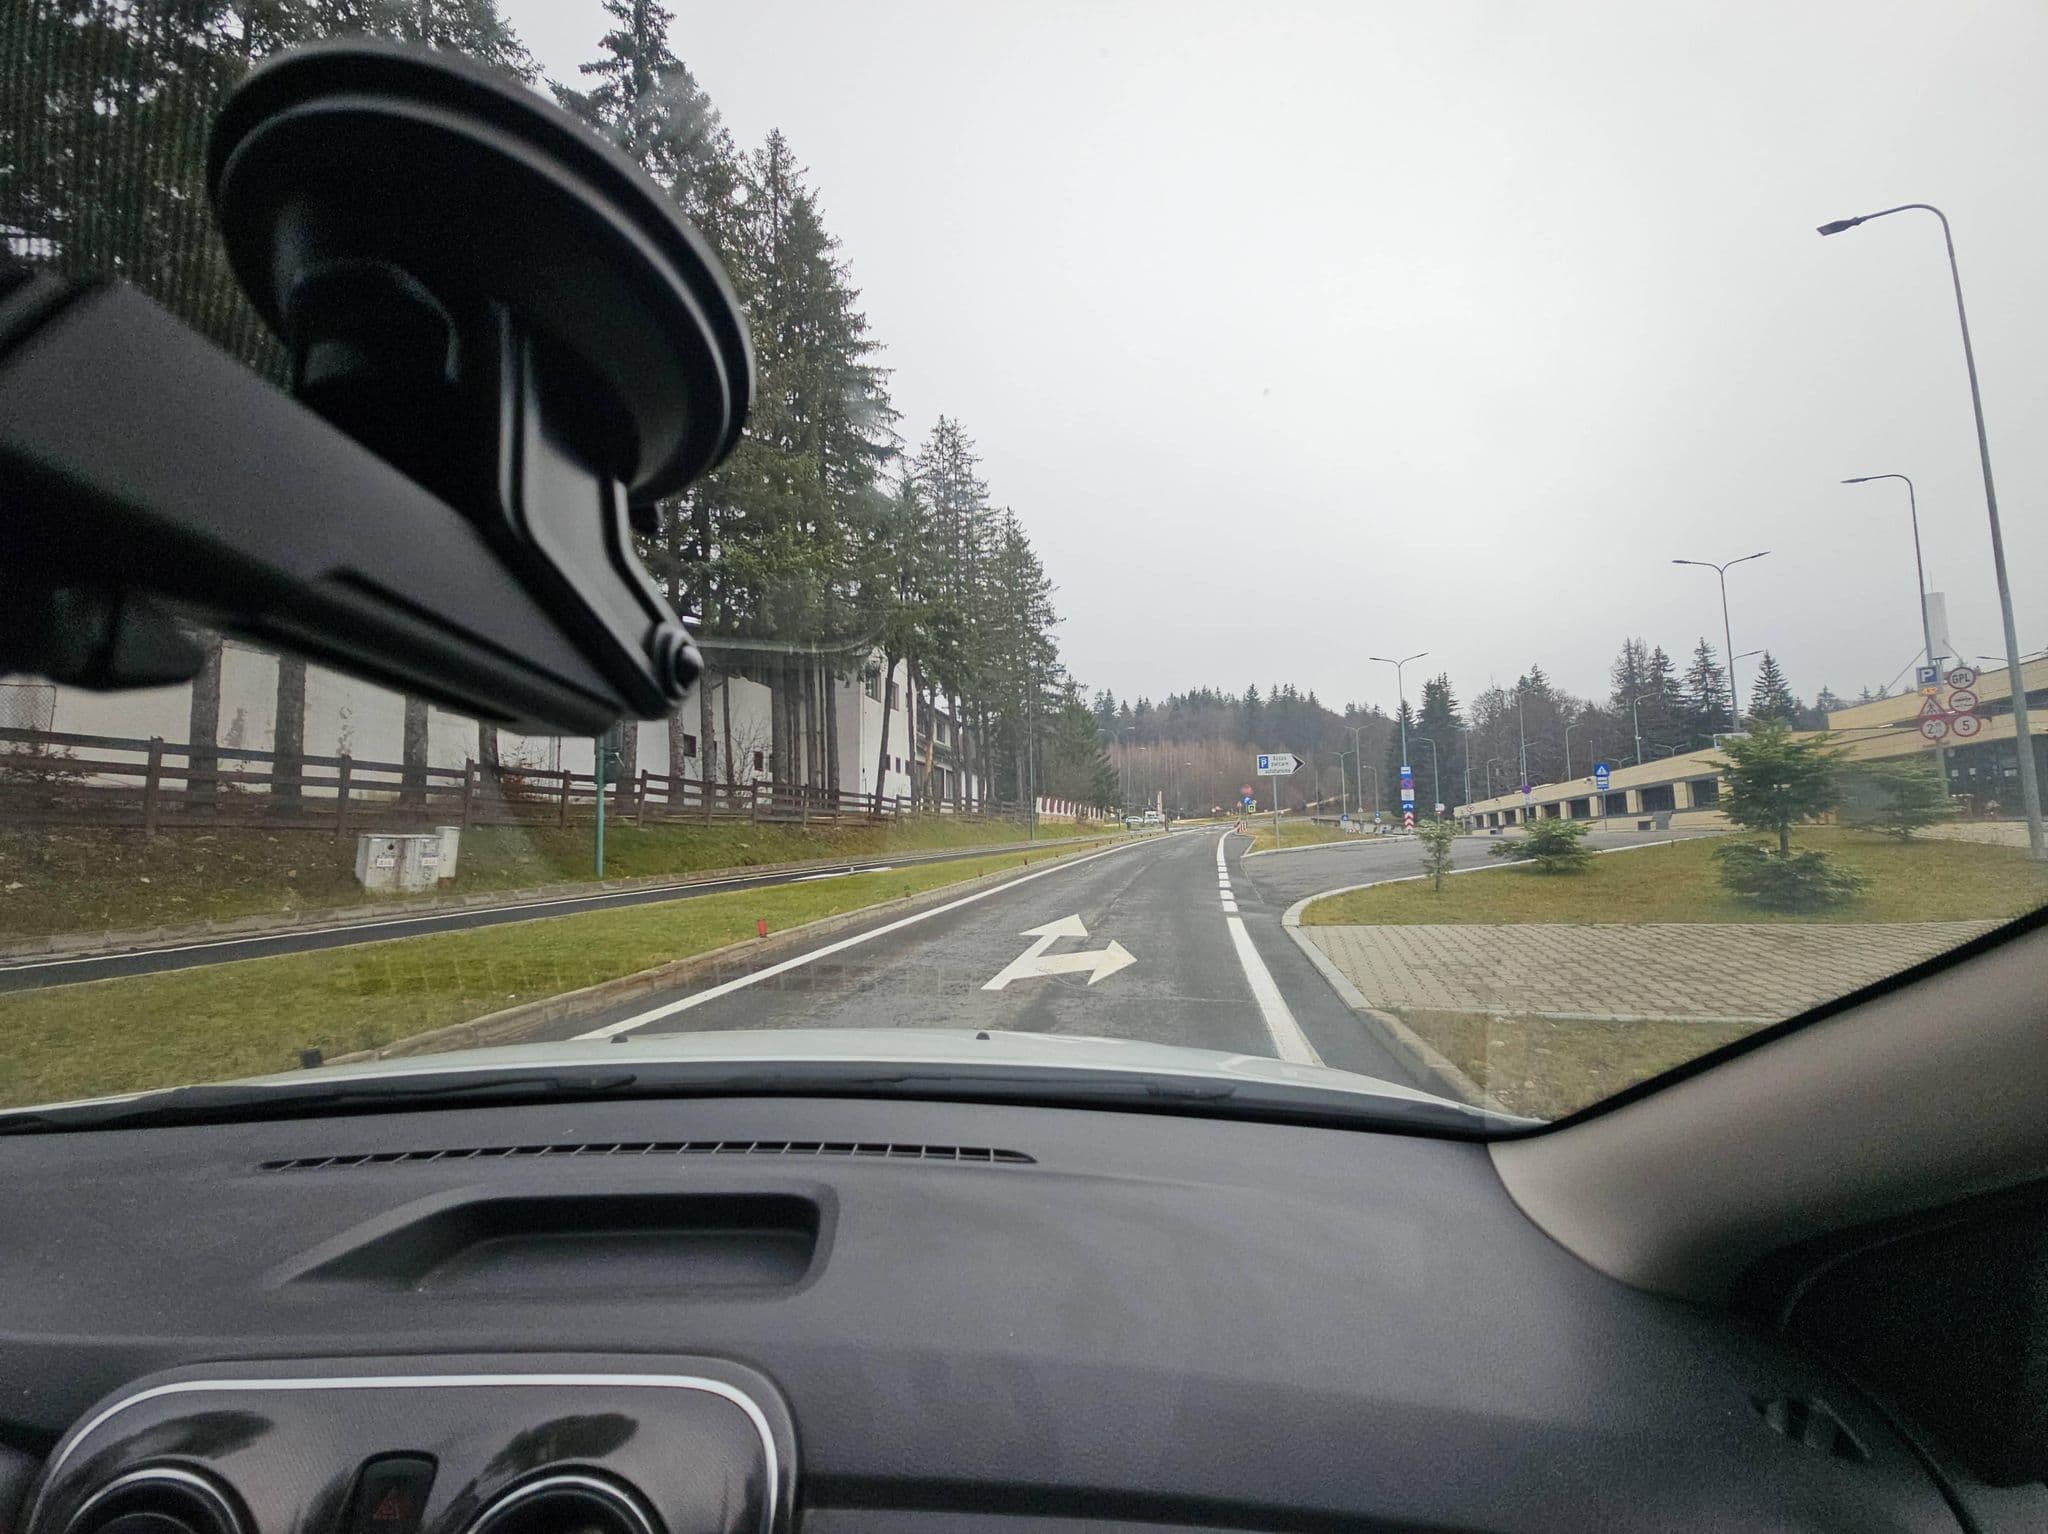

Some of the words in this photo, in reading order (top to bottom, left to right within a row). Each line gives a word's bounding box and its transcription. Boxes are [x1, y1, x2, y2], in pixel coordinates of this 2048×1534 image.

[1921, 669, 1934, 682] P
[1952, 673, 1970, 684] GPL
[1962, 720, 1970, 731] 5
